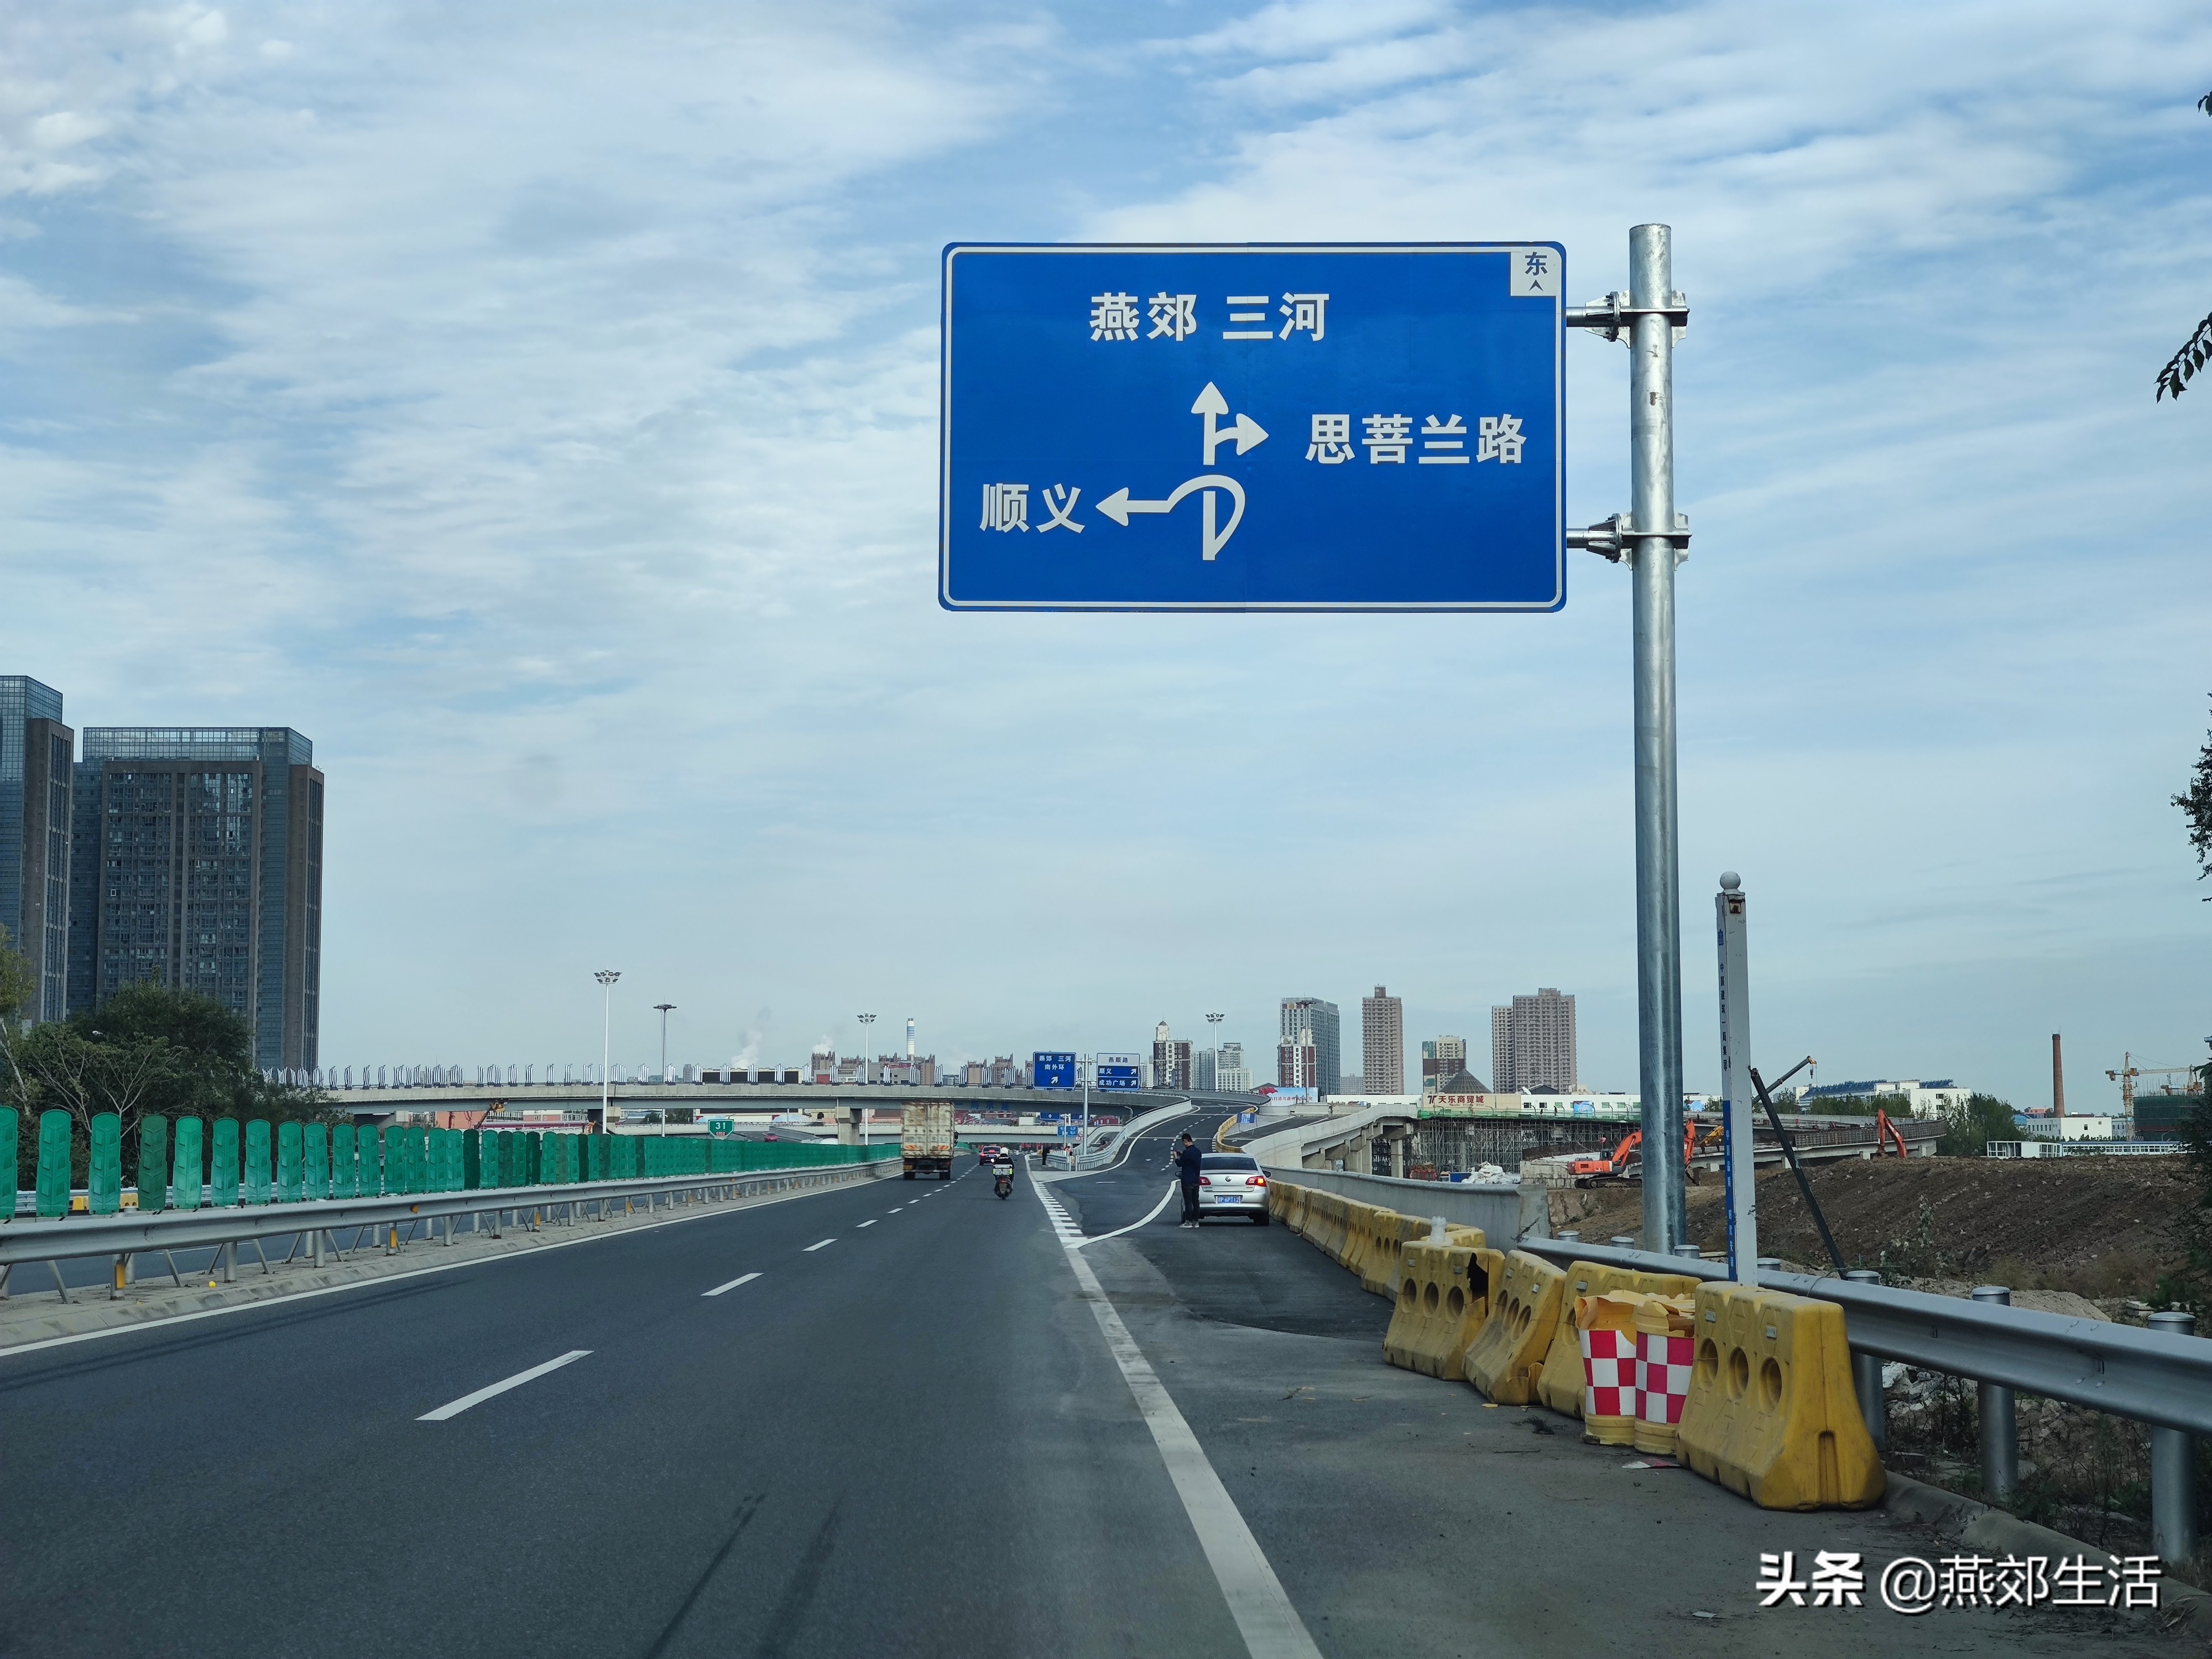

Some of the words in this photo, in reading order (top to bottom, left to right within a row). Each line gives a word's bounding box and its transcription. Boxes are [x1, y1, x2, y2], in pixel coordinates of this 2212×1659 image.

[1525, 252, 1547, 275] 东
[1090, 292, 1196, 341] 燕郊
[1223, 293, 1329, 341] 三河
[1306, 414, 1526, 463] 思菩兰路
[980, 483, 1084, 533] 顺义
